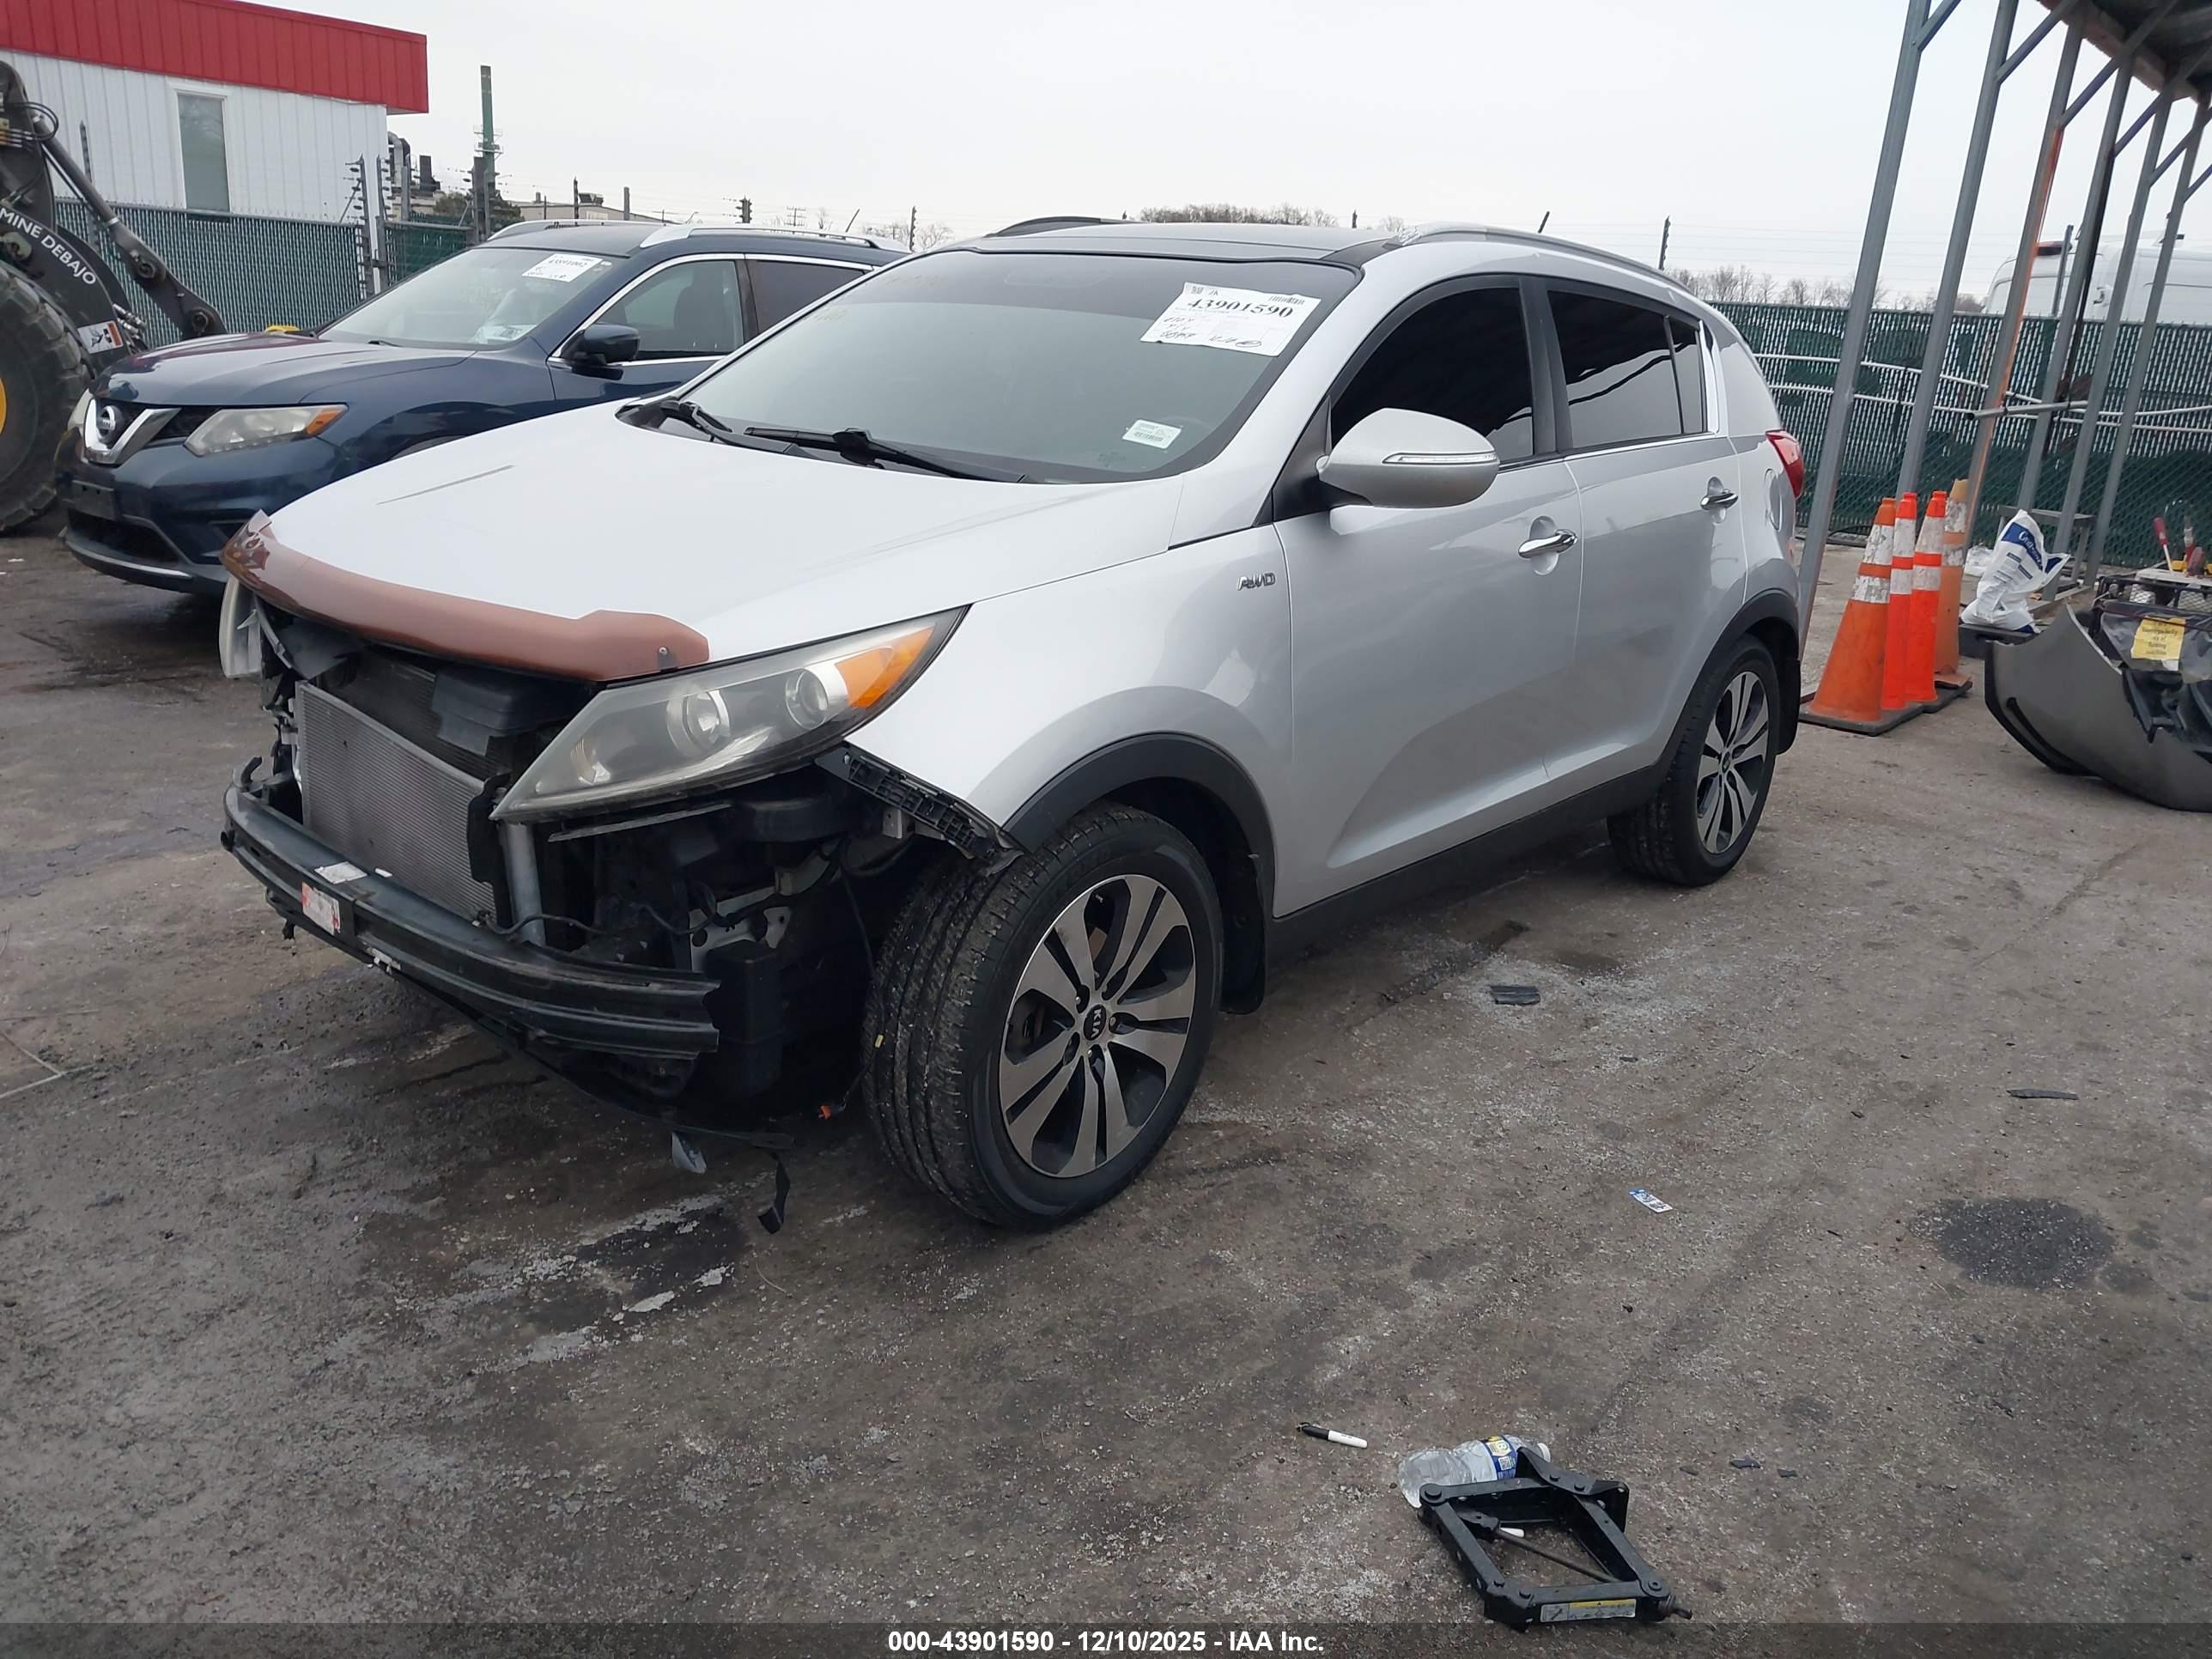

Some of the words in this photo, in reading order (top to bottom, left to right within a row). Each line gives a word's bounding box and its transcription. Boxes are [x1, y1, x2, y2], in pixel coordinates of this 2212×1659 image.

[0, 207, 42, 238] MINE
[40, 234, 96, 284] DEBAJO
[1187, 298, 1293, 318] 43901590
[1237, 572, 1276, 591] AWD
[1091, 1008, 1102, 1038] KIA
